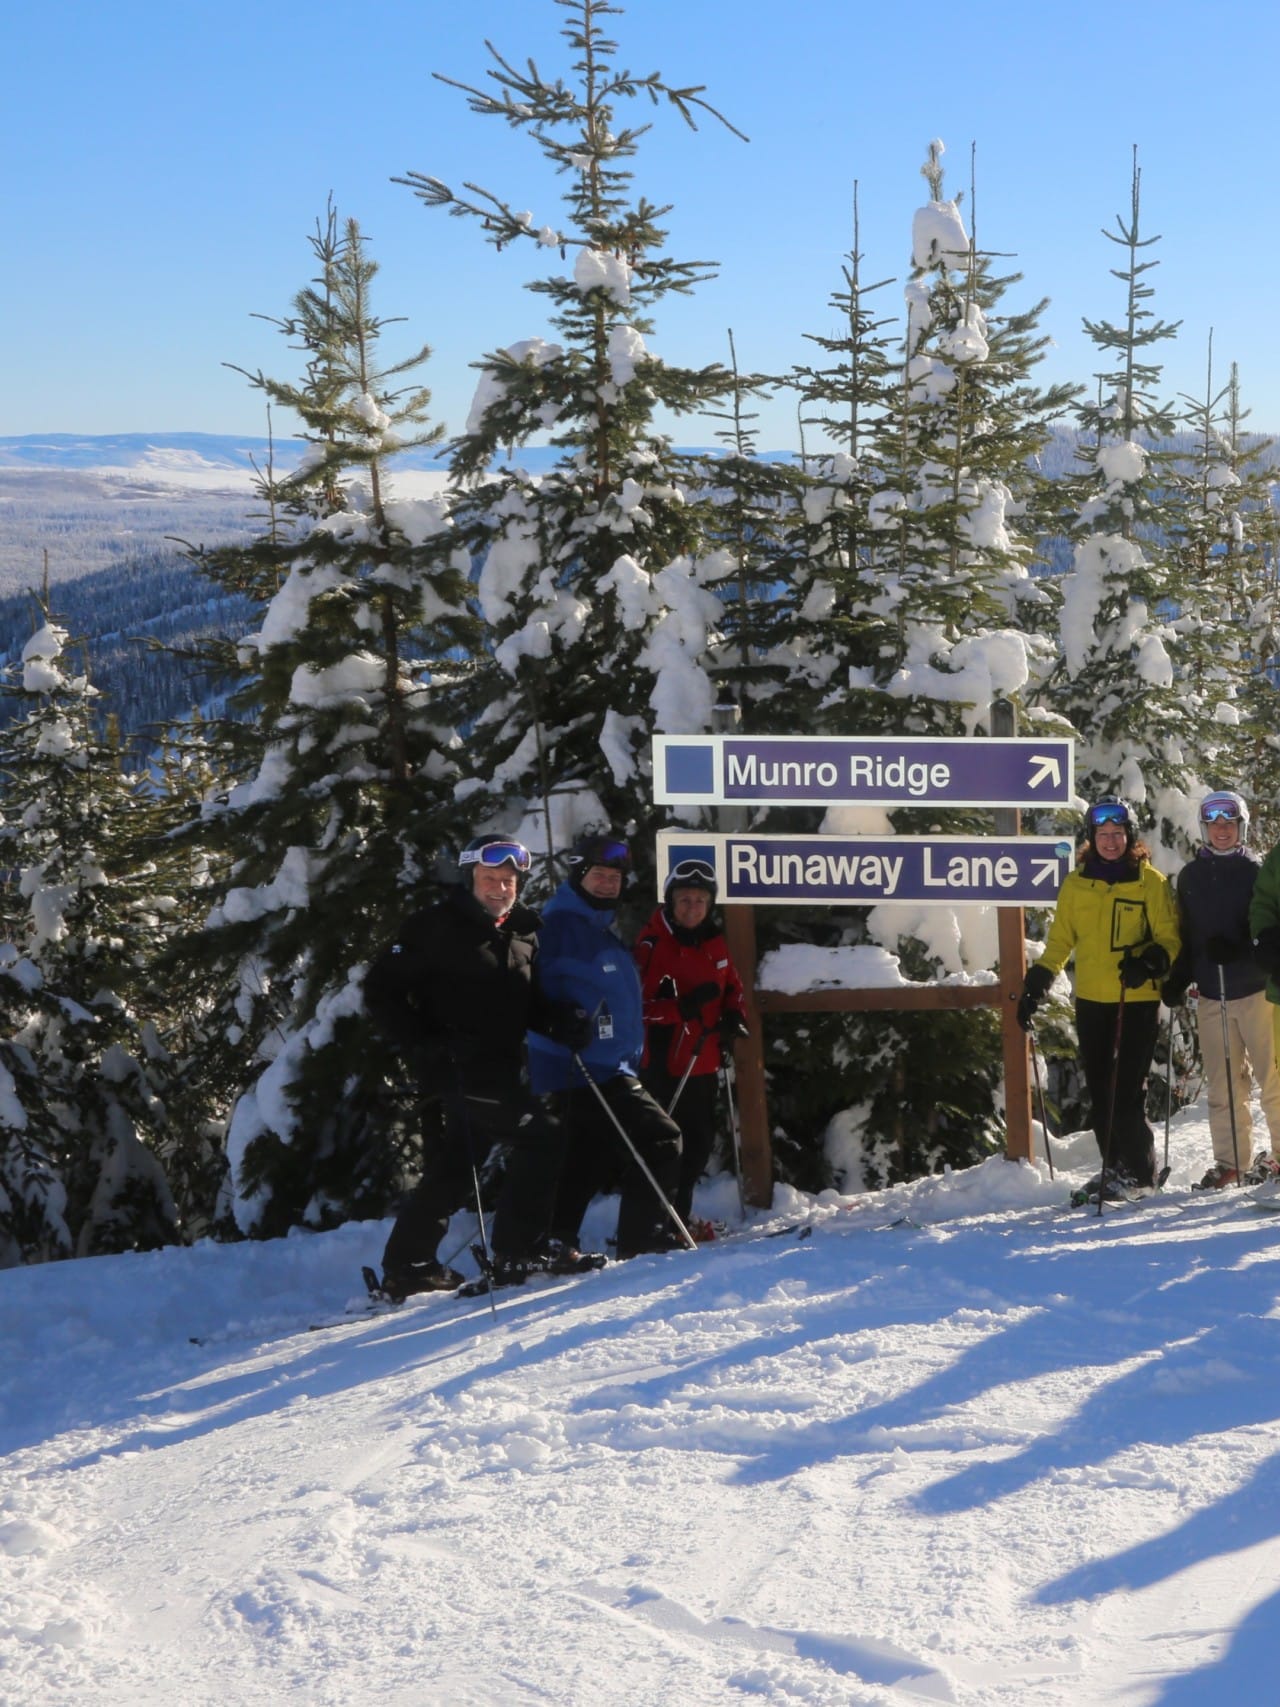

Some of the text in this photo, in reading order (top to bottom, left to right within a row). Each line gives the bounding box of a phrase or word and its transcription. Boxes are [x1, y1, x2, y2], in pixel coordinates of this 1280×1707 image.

[727, 754, 951, 796] Munro Ridge
[730, 844, 1019, 895] Runaway Lane
